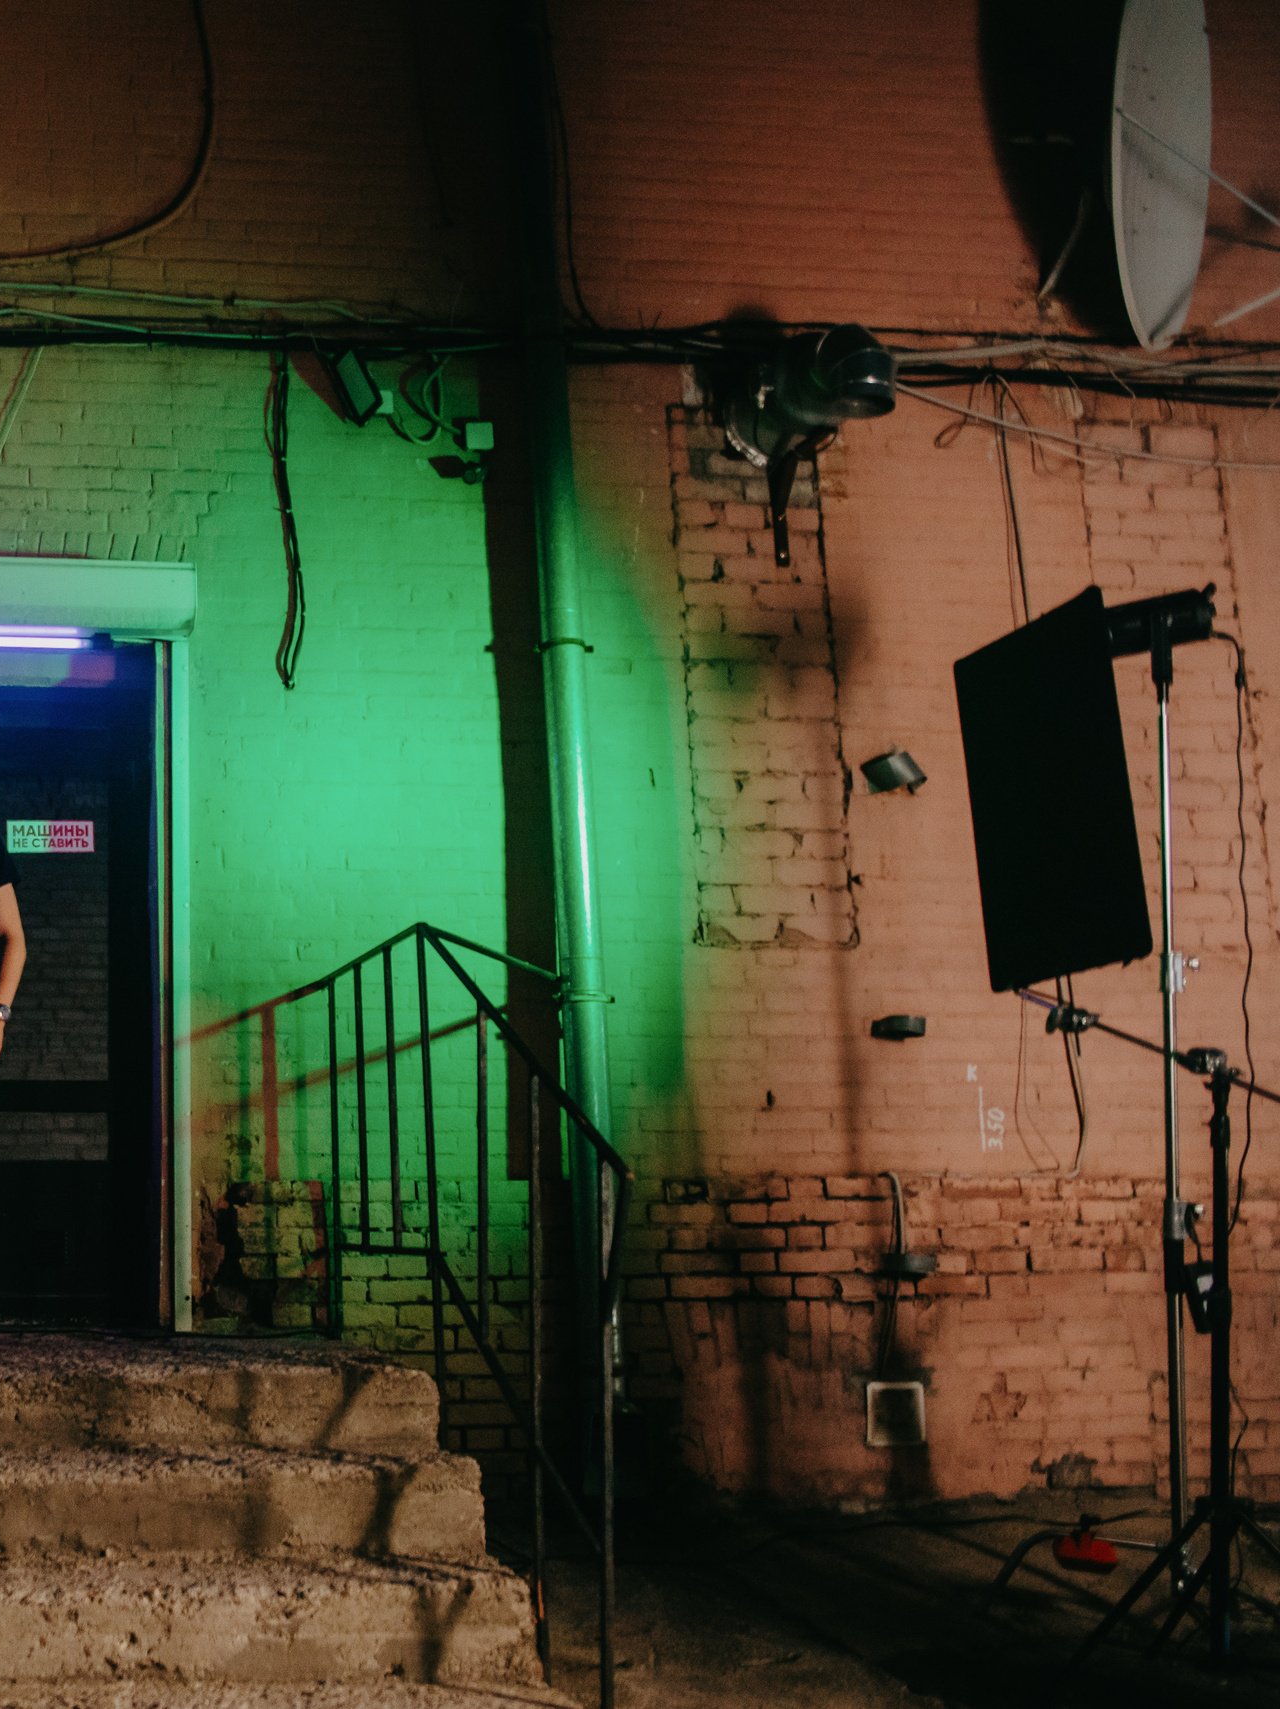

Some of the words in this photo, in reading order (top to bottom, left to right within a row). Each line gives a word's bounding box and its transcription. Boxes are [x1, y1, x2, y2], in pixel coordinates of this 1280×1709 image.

[12, 825, 89, 837] МАШИНЫ
[12, 838, 28, 848] НЕ
[31, 838, 89, 848] СТАВИТЬ
